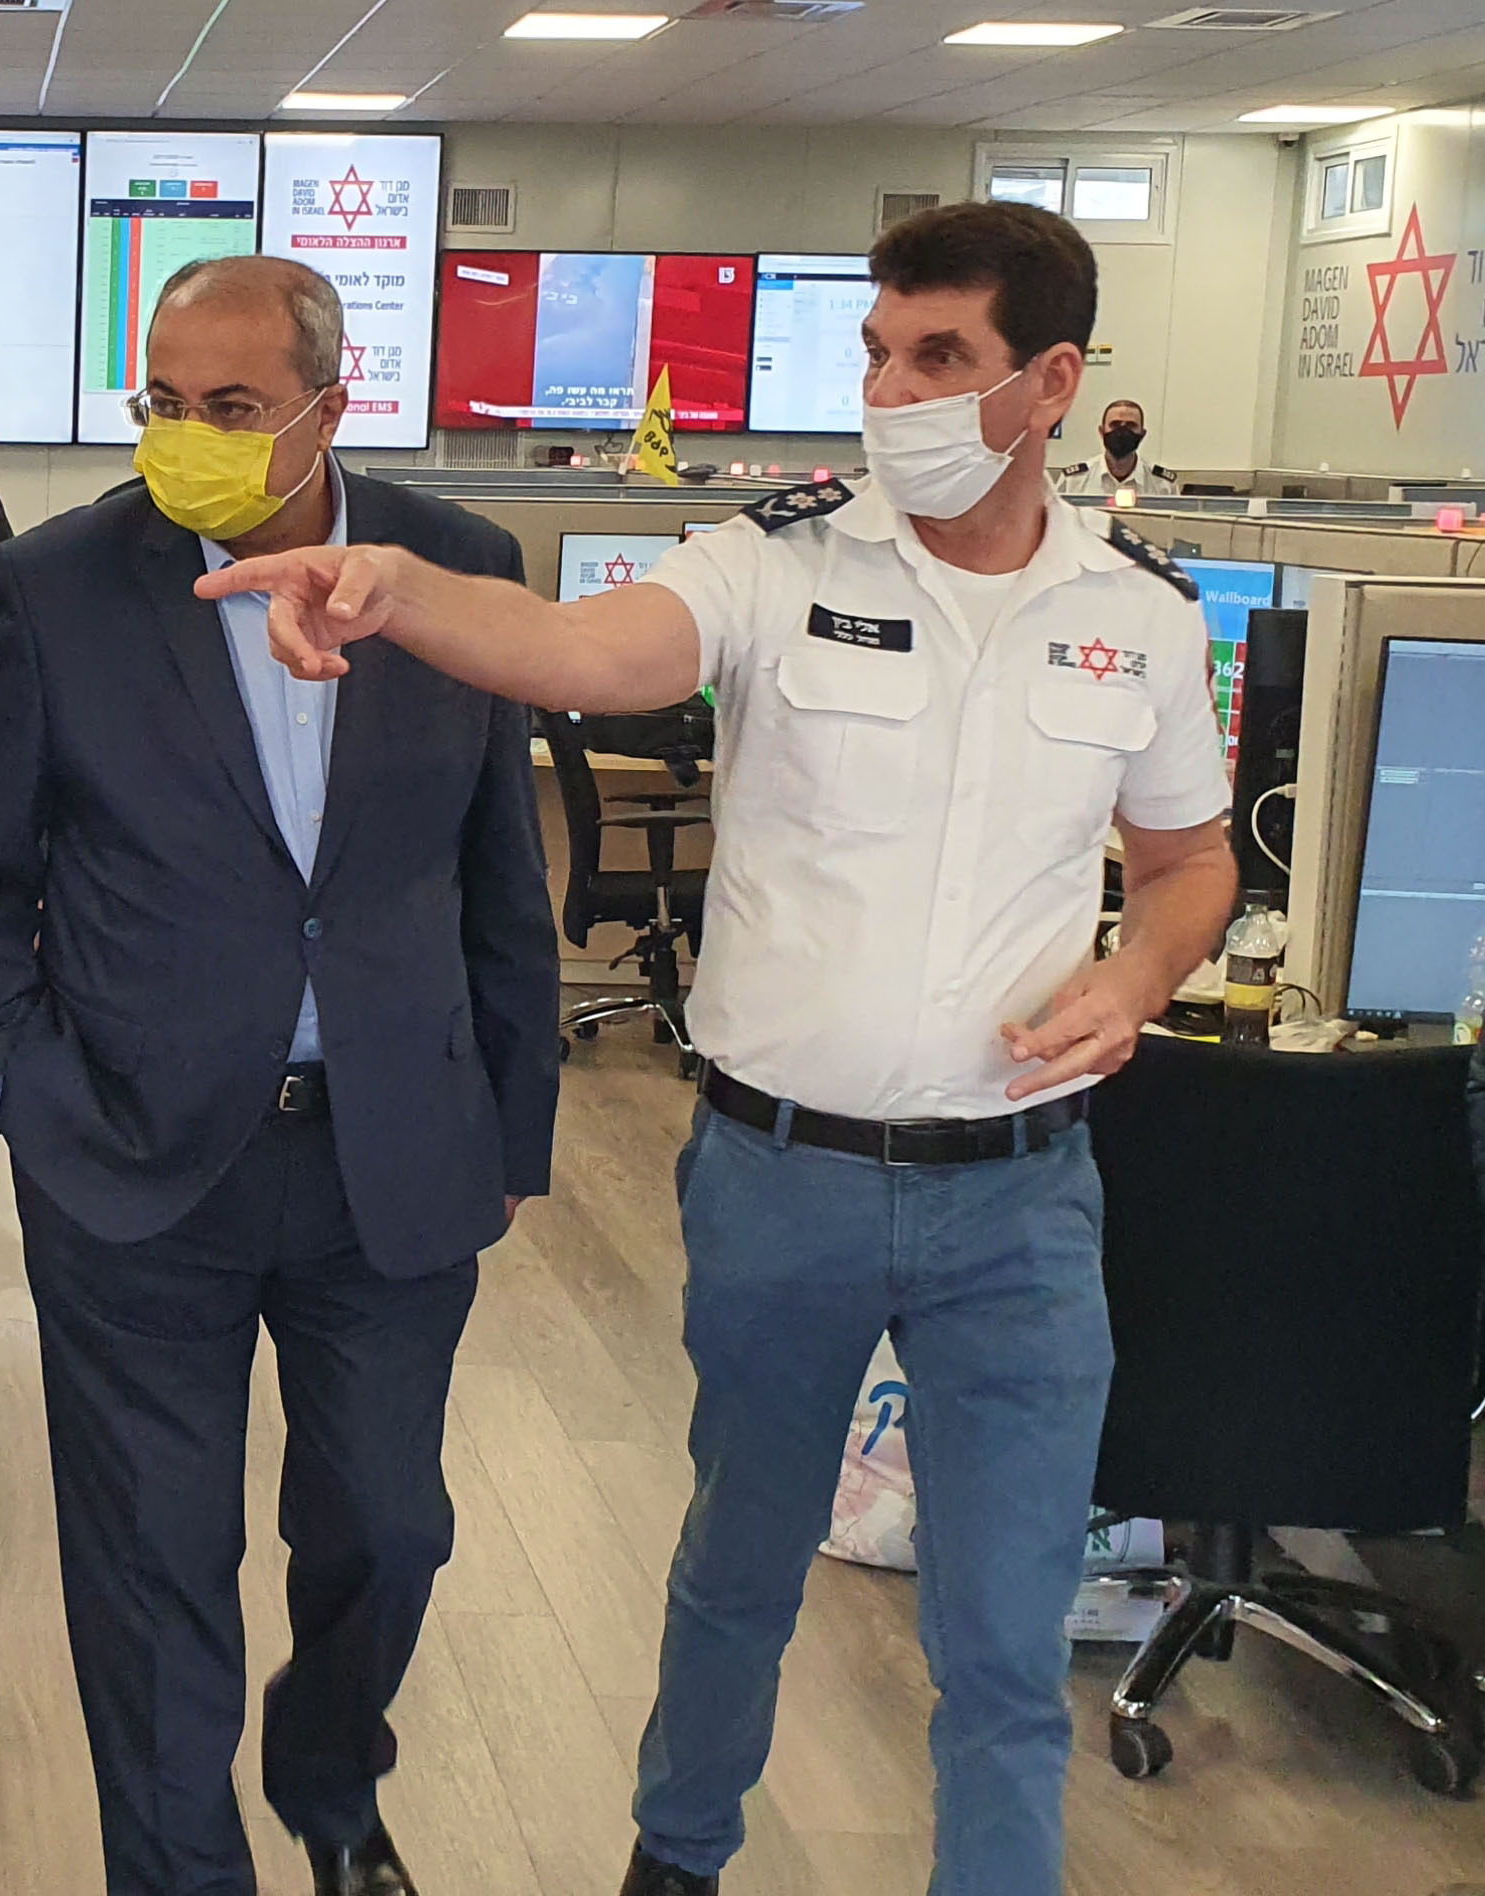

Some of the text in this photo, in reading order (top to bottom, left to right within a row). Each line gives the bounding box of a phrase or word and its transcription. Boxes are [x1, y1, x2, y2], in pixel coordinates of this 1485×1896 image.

[335, 272, 370, 287] לאומי
[374, 273, 405, 289] מוקד
[1305, 266, 1349, 292] MAGEN
[343, 301, 404, 310] rations Center
[1302, 296, 1340, 321] DAVID
[1300, 324, 1339, 350] ADOM
[1298, 352, 1355, 378] IN ISRAEL
[372, 403, 393, 411] EMS
[1205, 590, 1273, 606] Wallboard
